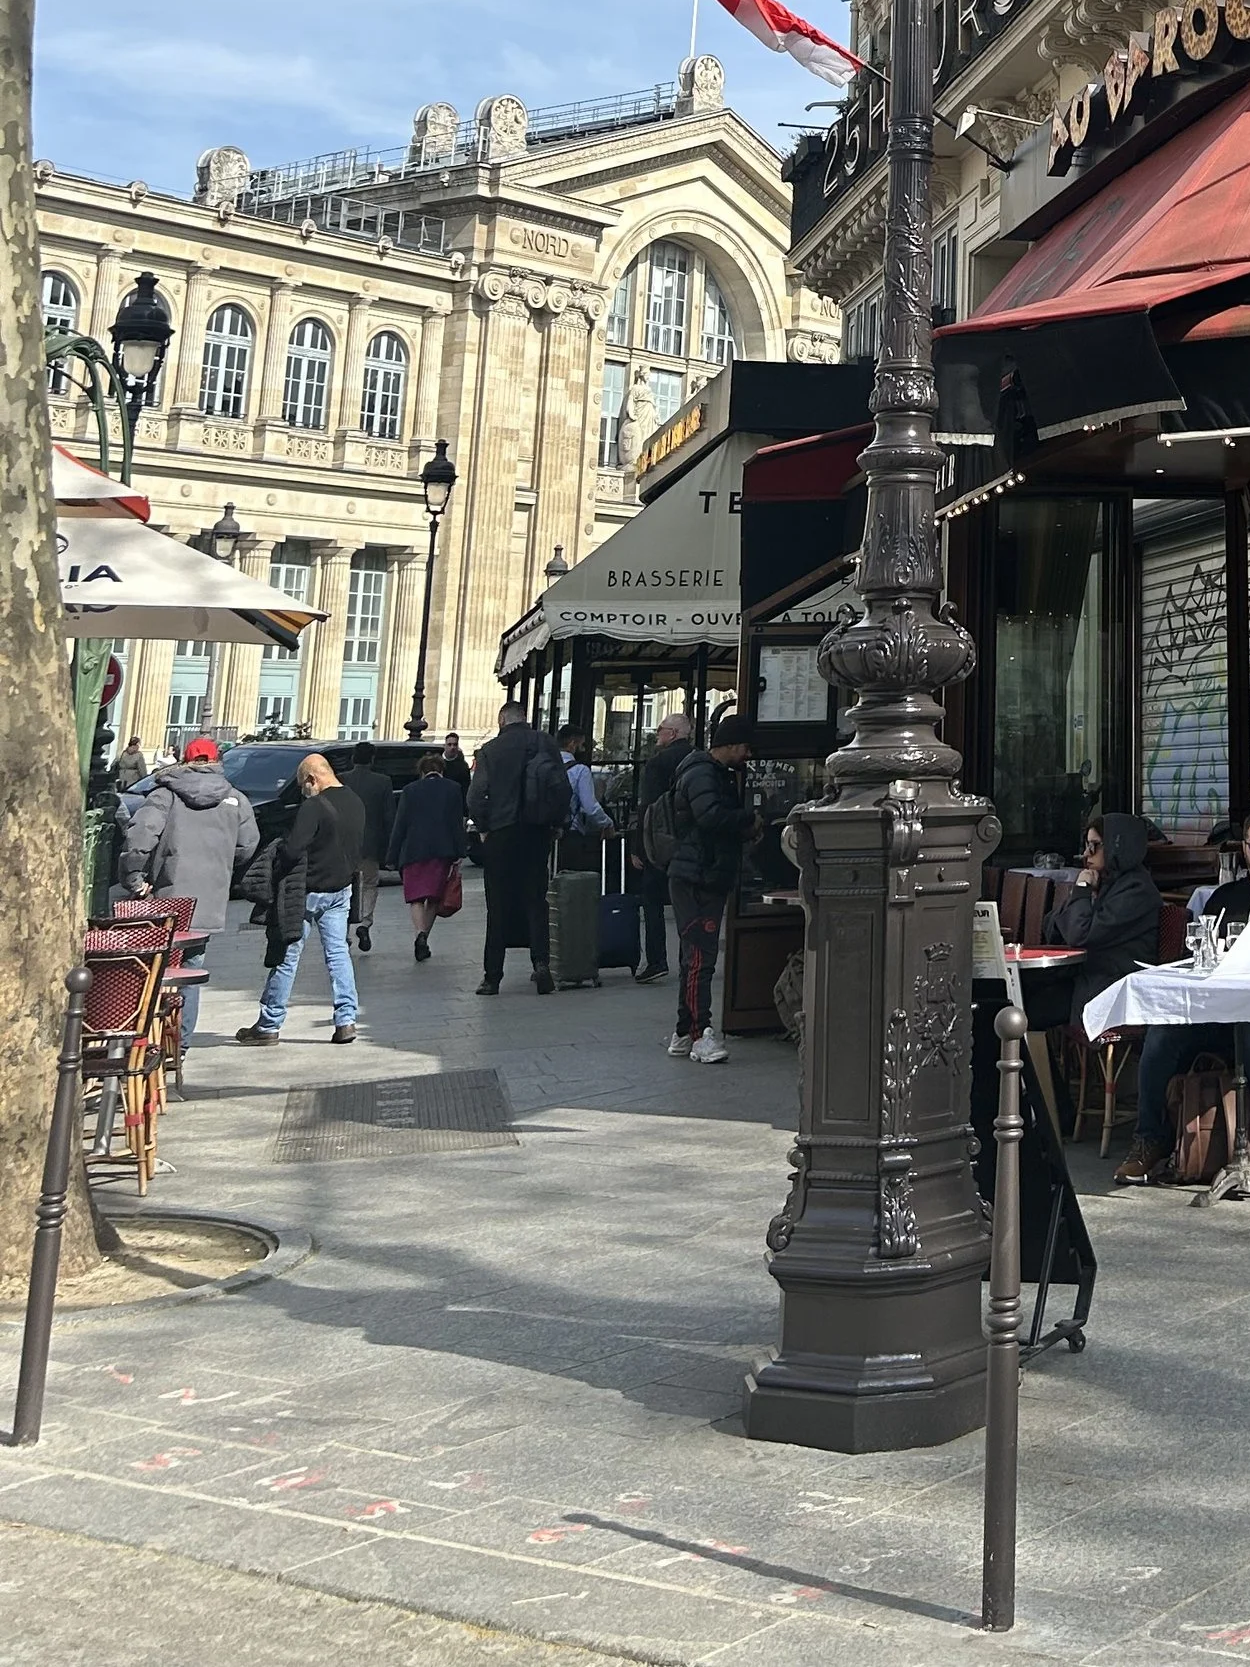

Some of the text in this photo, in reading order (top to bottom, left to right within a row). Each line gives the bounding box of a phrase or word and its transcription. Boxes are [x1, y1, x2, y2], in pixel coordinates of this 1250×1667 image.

[1047, 84, 1094, 177] AU
[522, 228, 569, 258] NORD
[607, 569, 724, 587] BRASSERIE
[559, 611, 667, 626] COMPTOIR
[775, 761, 796, 774] MER
